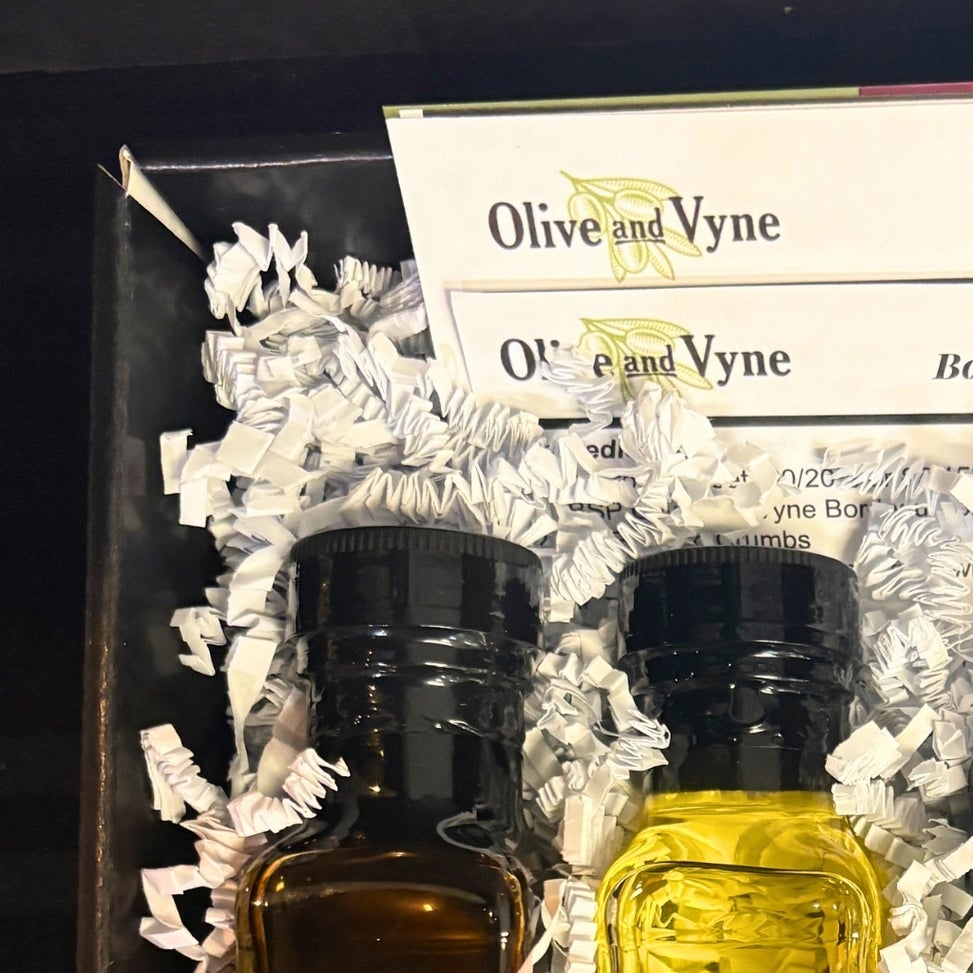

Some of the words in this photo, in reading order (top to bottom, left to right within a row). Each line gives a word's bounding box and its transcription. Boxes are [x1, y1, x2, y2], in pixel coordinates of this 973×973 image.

[488, 201, 602, 249] Olive
[612, 207, 666, 245] and
[668, 196, 780, 253] Vyne
[500, 338, 613, 381] Ole
[624, 344, 677, 379] and
[679, 334, 791, 386] Vyne
[777, 466, 836, 490] 0/20
[773, 503, 816, 524] yne
